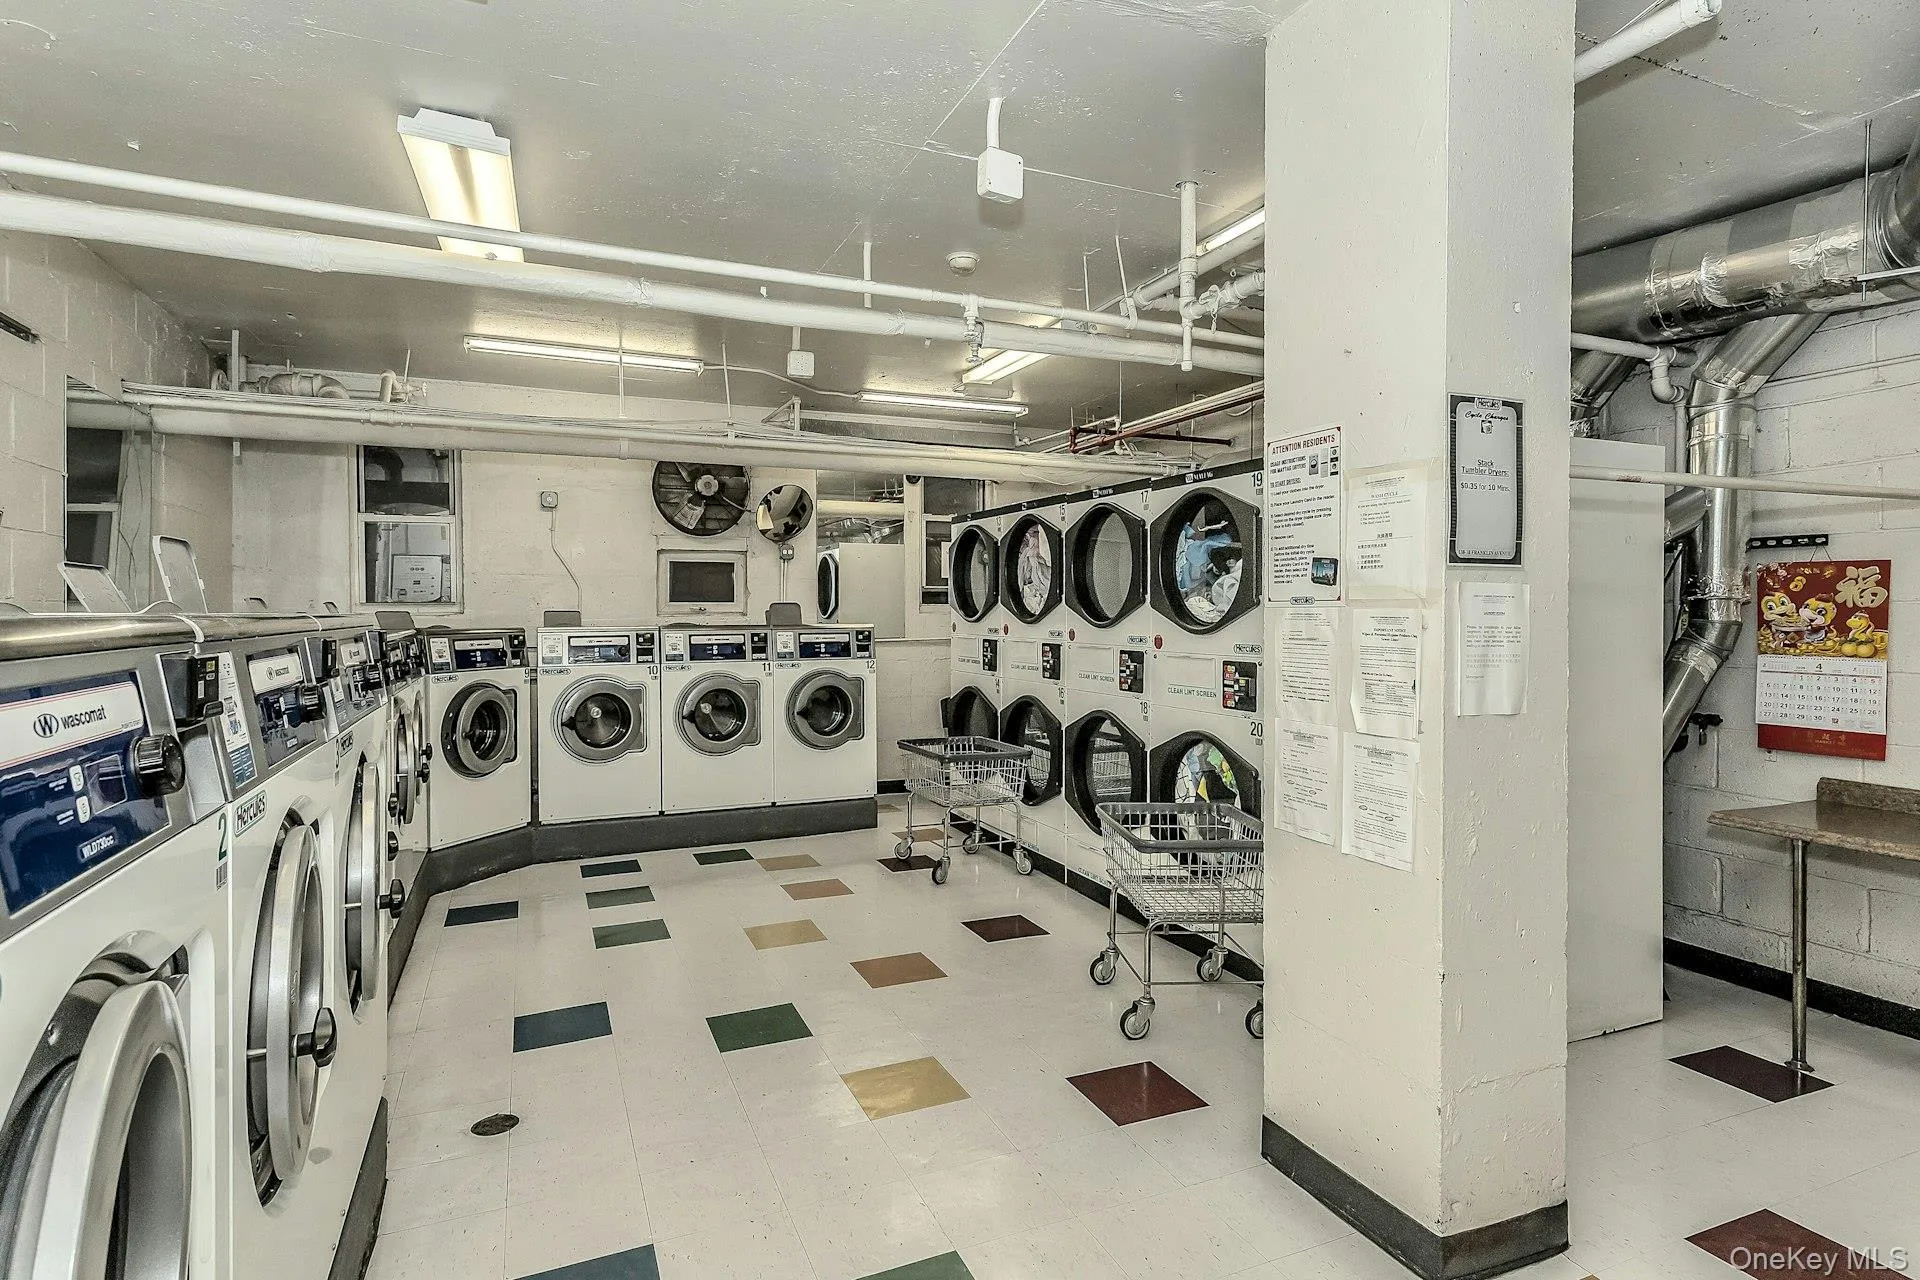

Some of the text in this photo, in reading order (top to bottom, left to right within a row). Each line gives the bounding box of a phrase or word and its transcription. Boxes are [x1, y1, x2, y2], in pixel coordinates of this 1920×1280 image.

[1464, 411, 1509, 421] Cycle Charges
[1272, 434, 1335, 455] ATTENTION RESIDENTS
[1477, 459, 1494, 467] Stack
[1461, 466, 1487, 475] Tumbler
[1251, 472, 1263, 487] 19
[1460, 482, 1478, 490] $0.35
[1479, 482, 1487, 490] for
[1140, 490, 1149, 503] 17
[1059, 504, 1066, 516] 15
[1835, 566, 1888, 608] 福
[1235, 643, 1261, 653] Hercules
[646, 665, 658, 675] 10
[762, 662, 771, 672] 11
[866, 660, 875, 669] 12
[524, 668, 530, 678] 9
[1168, 687, 1217, 698] CLEAN LINT SCREEN
[1140, 701, 1148, 714] 18
[61, 705, 107, 730] wascomat
[1250, 721, 1263, 737] 20
[236, 795, 266, 827] Hercules
[218, 812, 227, 862] 2
